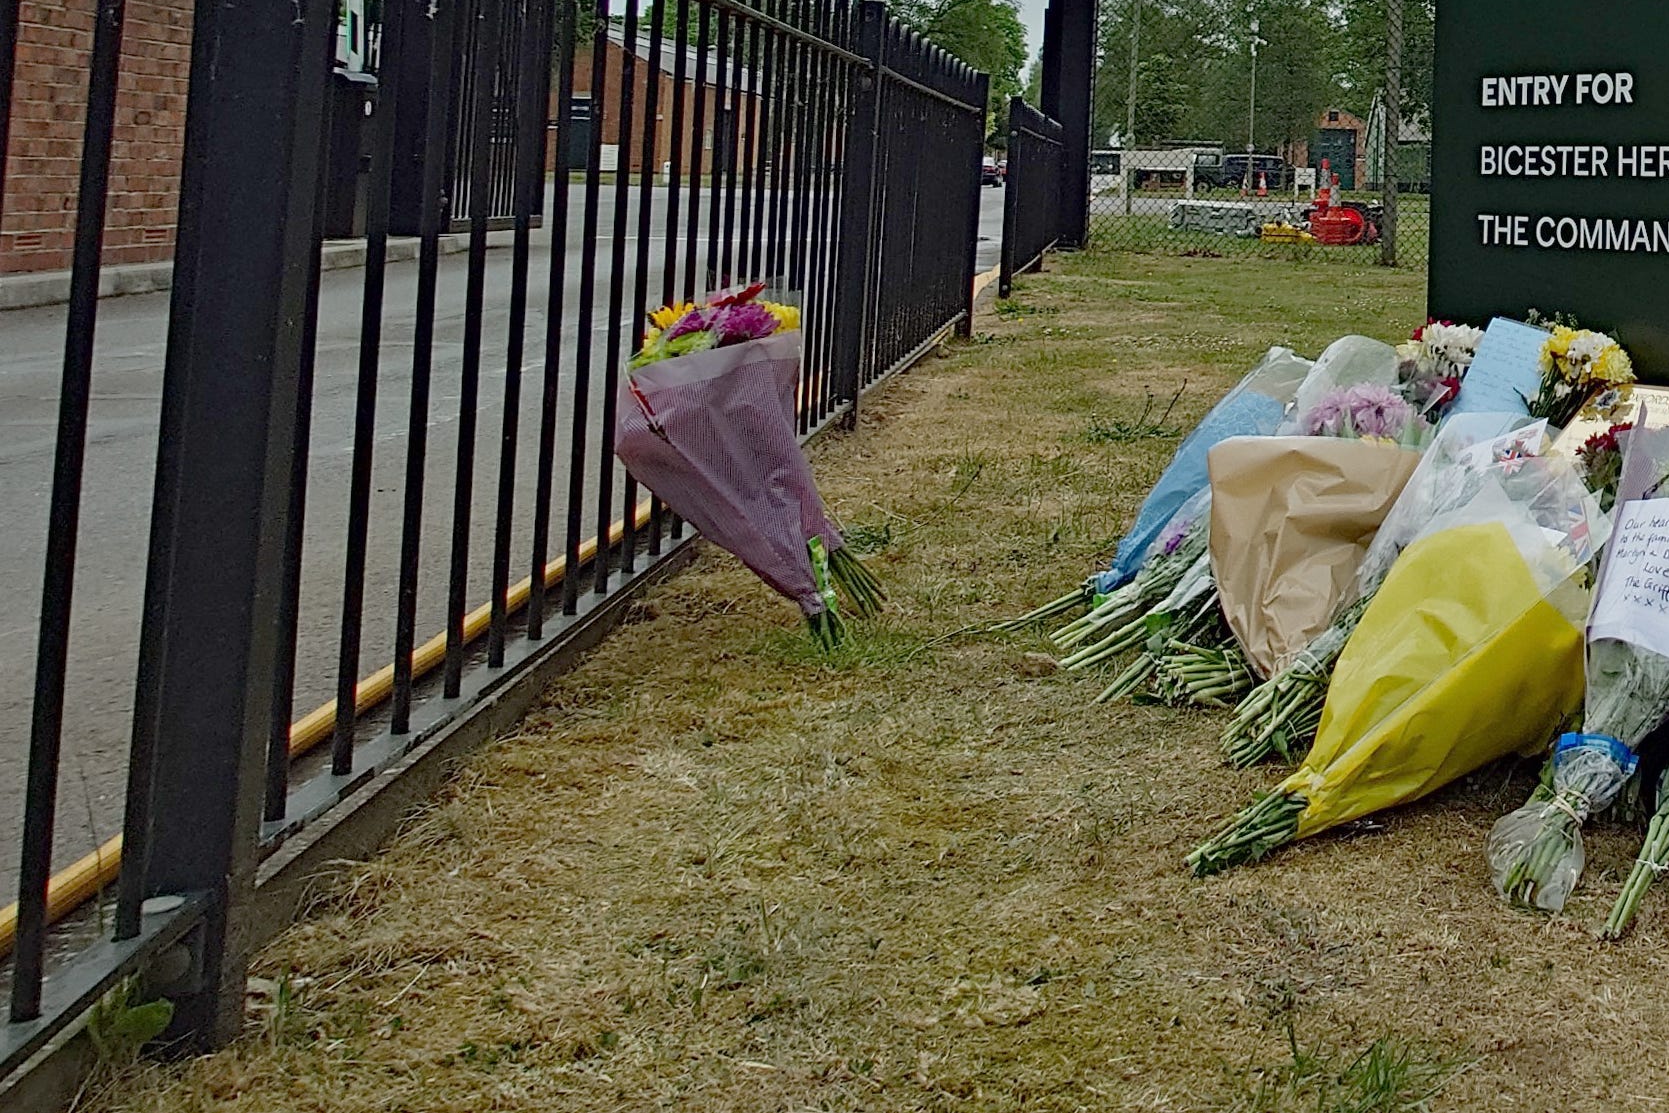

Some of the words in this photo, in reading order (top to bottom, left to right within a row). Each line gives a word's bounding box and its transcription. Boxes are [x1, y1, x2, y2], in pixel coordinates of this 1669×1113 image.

[1481, 74, 1570, 107] ENTRY
[1576, 72, 1634, 105] FOR
[1480, 145, 1609, 177] BICESTER
[1477, 214, 1529, 246] THE
[1624, 518, 1646, 530] Our
[1632, 532, 1646, 543] the
[1624, 575, 1640, 588] The
